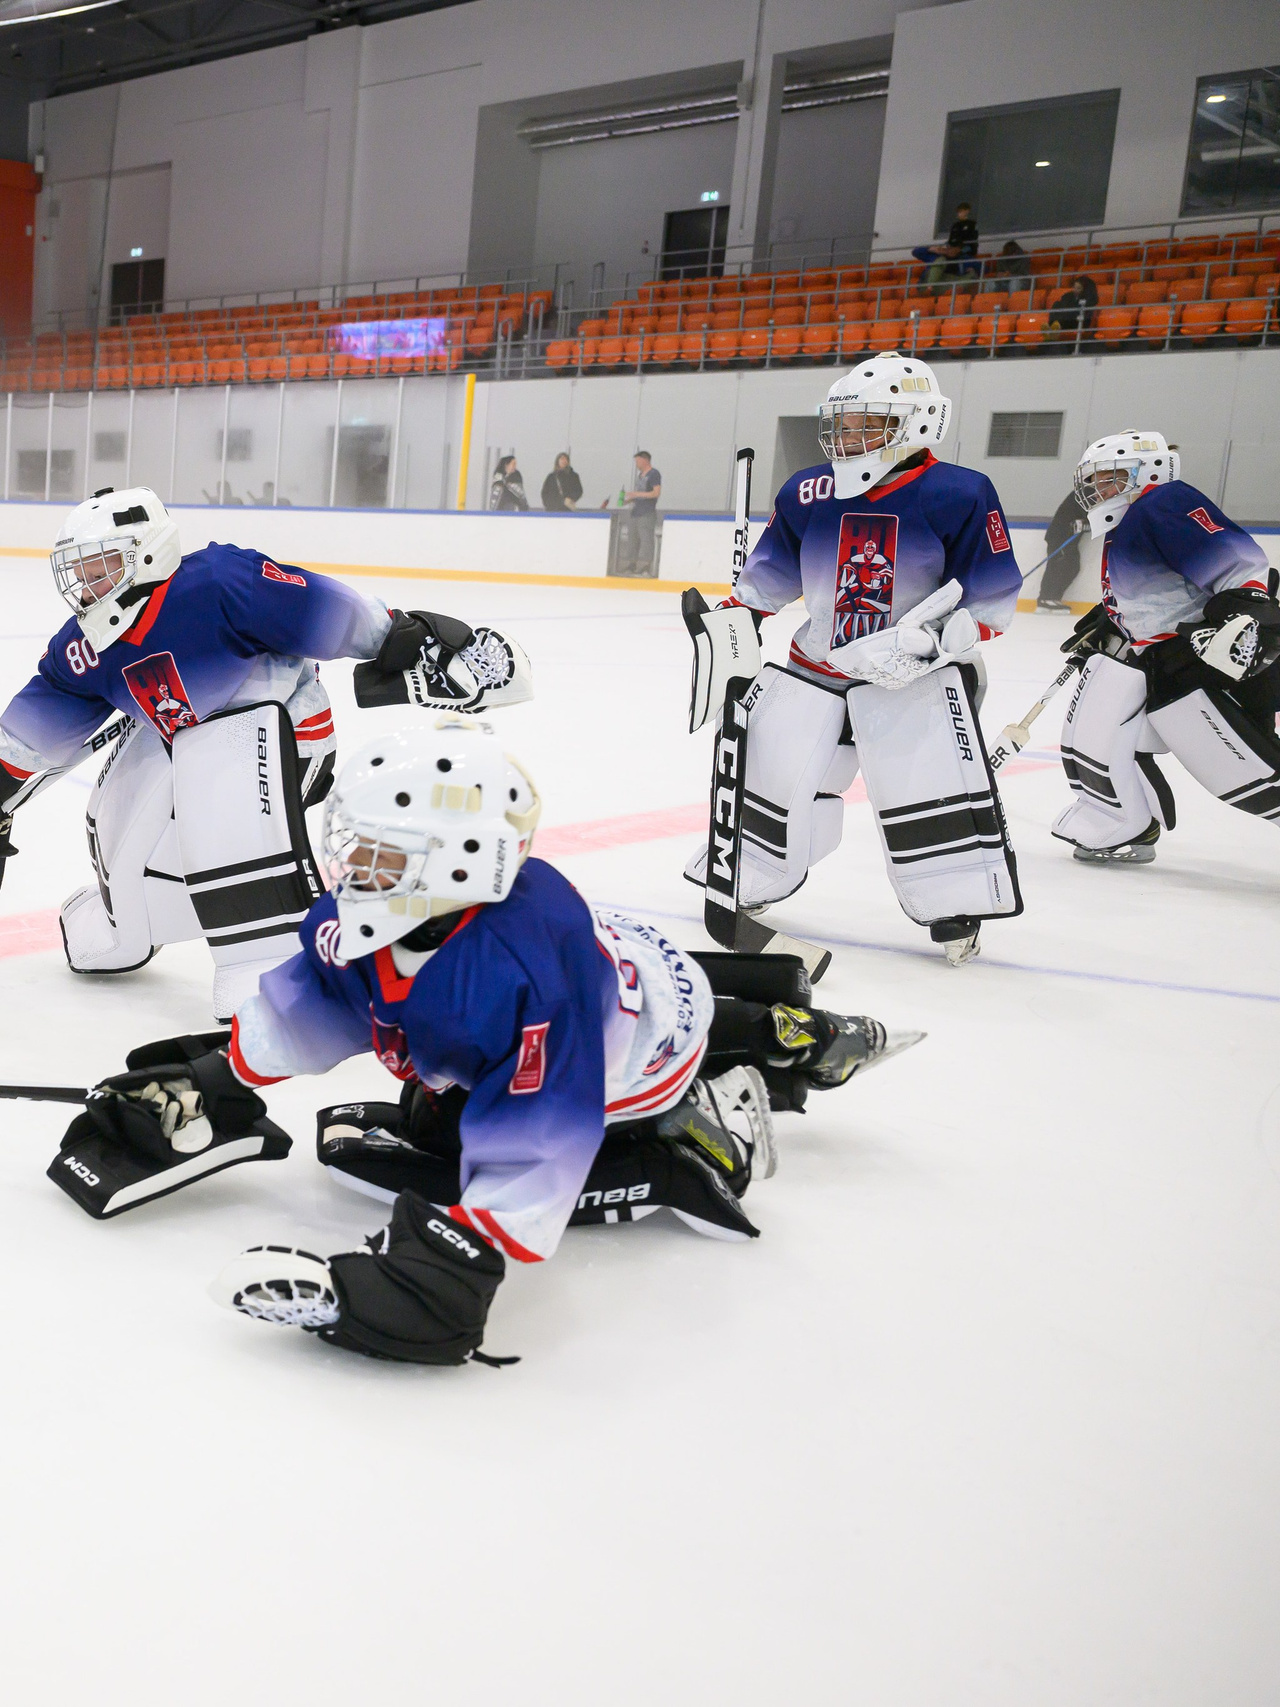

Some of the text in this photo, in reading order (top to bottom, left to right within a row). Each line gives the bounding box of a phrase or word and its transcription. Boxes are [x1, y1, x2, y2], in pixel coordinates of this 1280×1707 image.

[828, 394, 860, 402] BAUER
[935, 403, 948, 441] BAUER
[798, 475, 835, 505] 80
[65, 639, 100, 676] 80
[1056, 661, 1079, 687] BAU
[744, 683, 764, 712] ER
[1066, 667, 1092, 724] BAUER
[945, 686, 973, 761] BAUER
[1200, 710, 1246, 761] BAUER
[97, 717, 136, 789] BAUER
[257, 727, 272, 816] BAUER
[988, 746, 1010, 770] ER
[712, 736, 739, 882] CCM
[492, 838, 508, 896] BAUER
[63, 1156, 101, 1188] CCM
[577, 1182, 651, 1210] BAU
[426, 1218, 481, 1260] CCM
